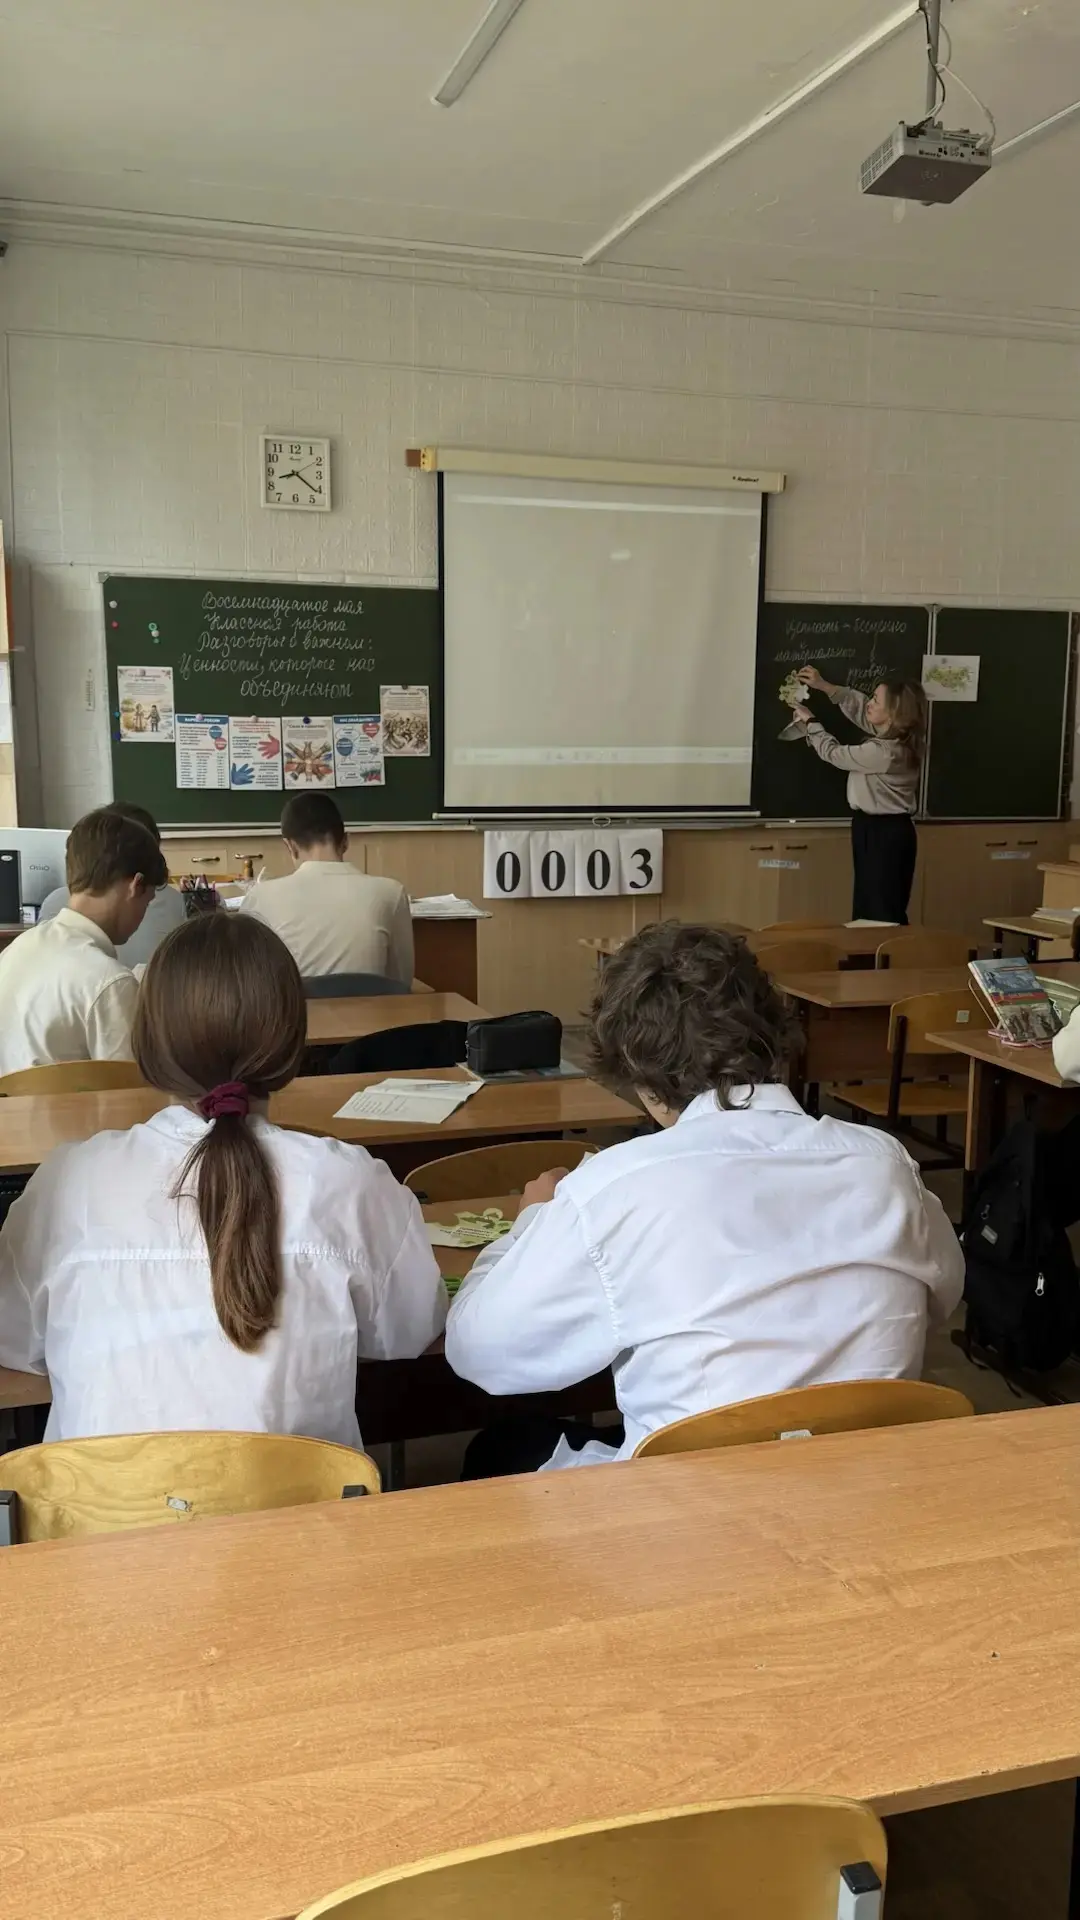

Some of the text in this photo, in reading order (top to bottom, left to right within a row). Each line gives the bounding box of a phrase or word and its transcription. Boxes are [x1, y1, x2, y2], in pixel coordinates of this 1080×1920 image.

[273, 443, 283, 453] 11
[289, 444, 301, 454] 12
[268, 453, 279, 463] 10
[315, 457, 322, 466] 2
[268, 467, 274, 477] 9
[316, 471, 322, 480] 3
[268, 481, 275, 491] 8
[276, 493, 282, 502] 7
[292, 494, 299, 503] 6
[309, 495, 316, 504] 5
[201, 591, 364, 618] Восемнадцатое мая
[204, 612, 347, 638] Классная работа
[198, 631, 286, 657] Разговоры
[346, 657, 376, 672] нас
[241, 677, 353, 707] объединяют
